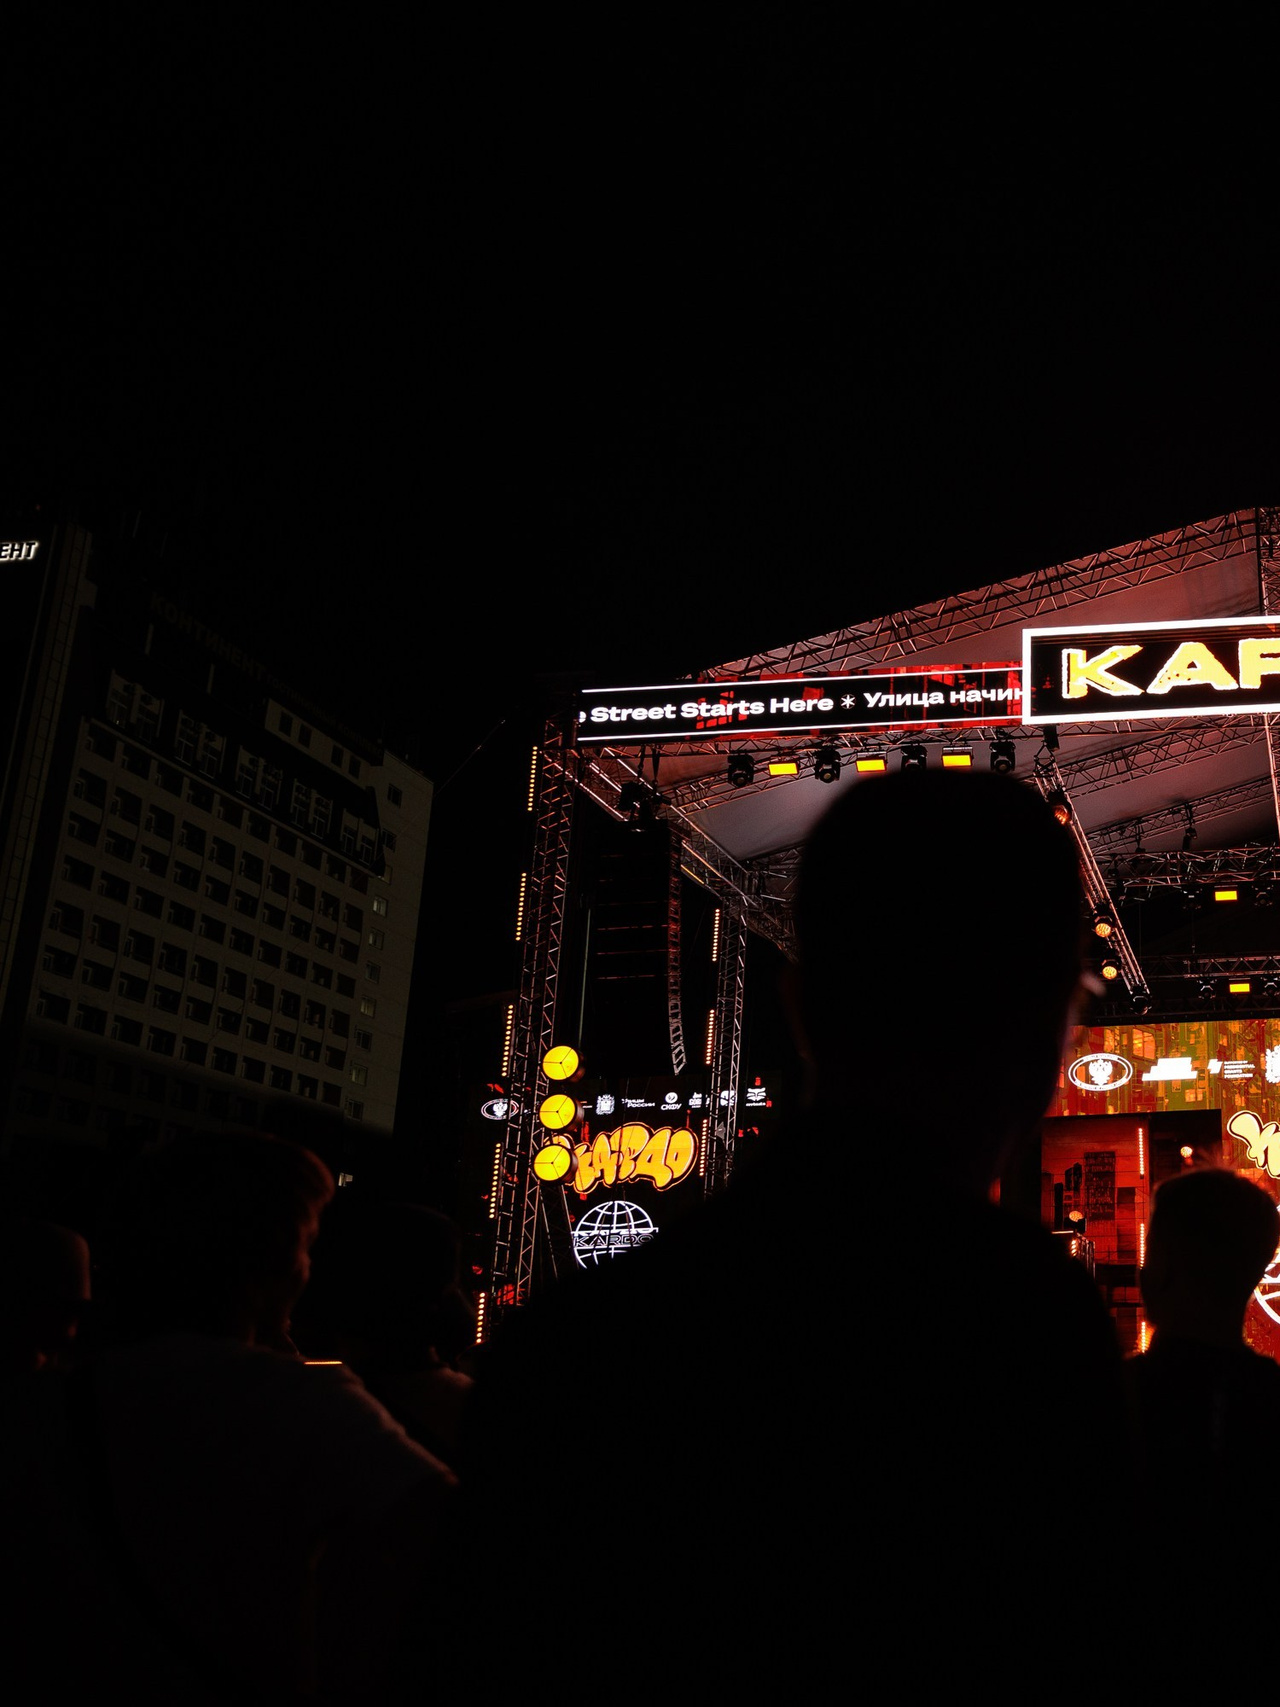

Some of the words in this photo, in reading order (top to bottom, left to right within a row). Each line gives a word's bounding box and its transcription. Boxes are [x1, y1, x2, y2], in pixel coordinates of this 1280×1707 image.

[590, 703, 677, 722] Street
[680, 699, 765, 718] Starts
[770, 695, 834, 714] Here
[863, 691, 945, 708] Улица
